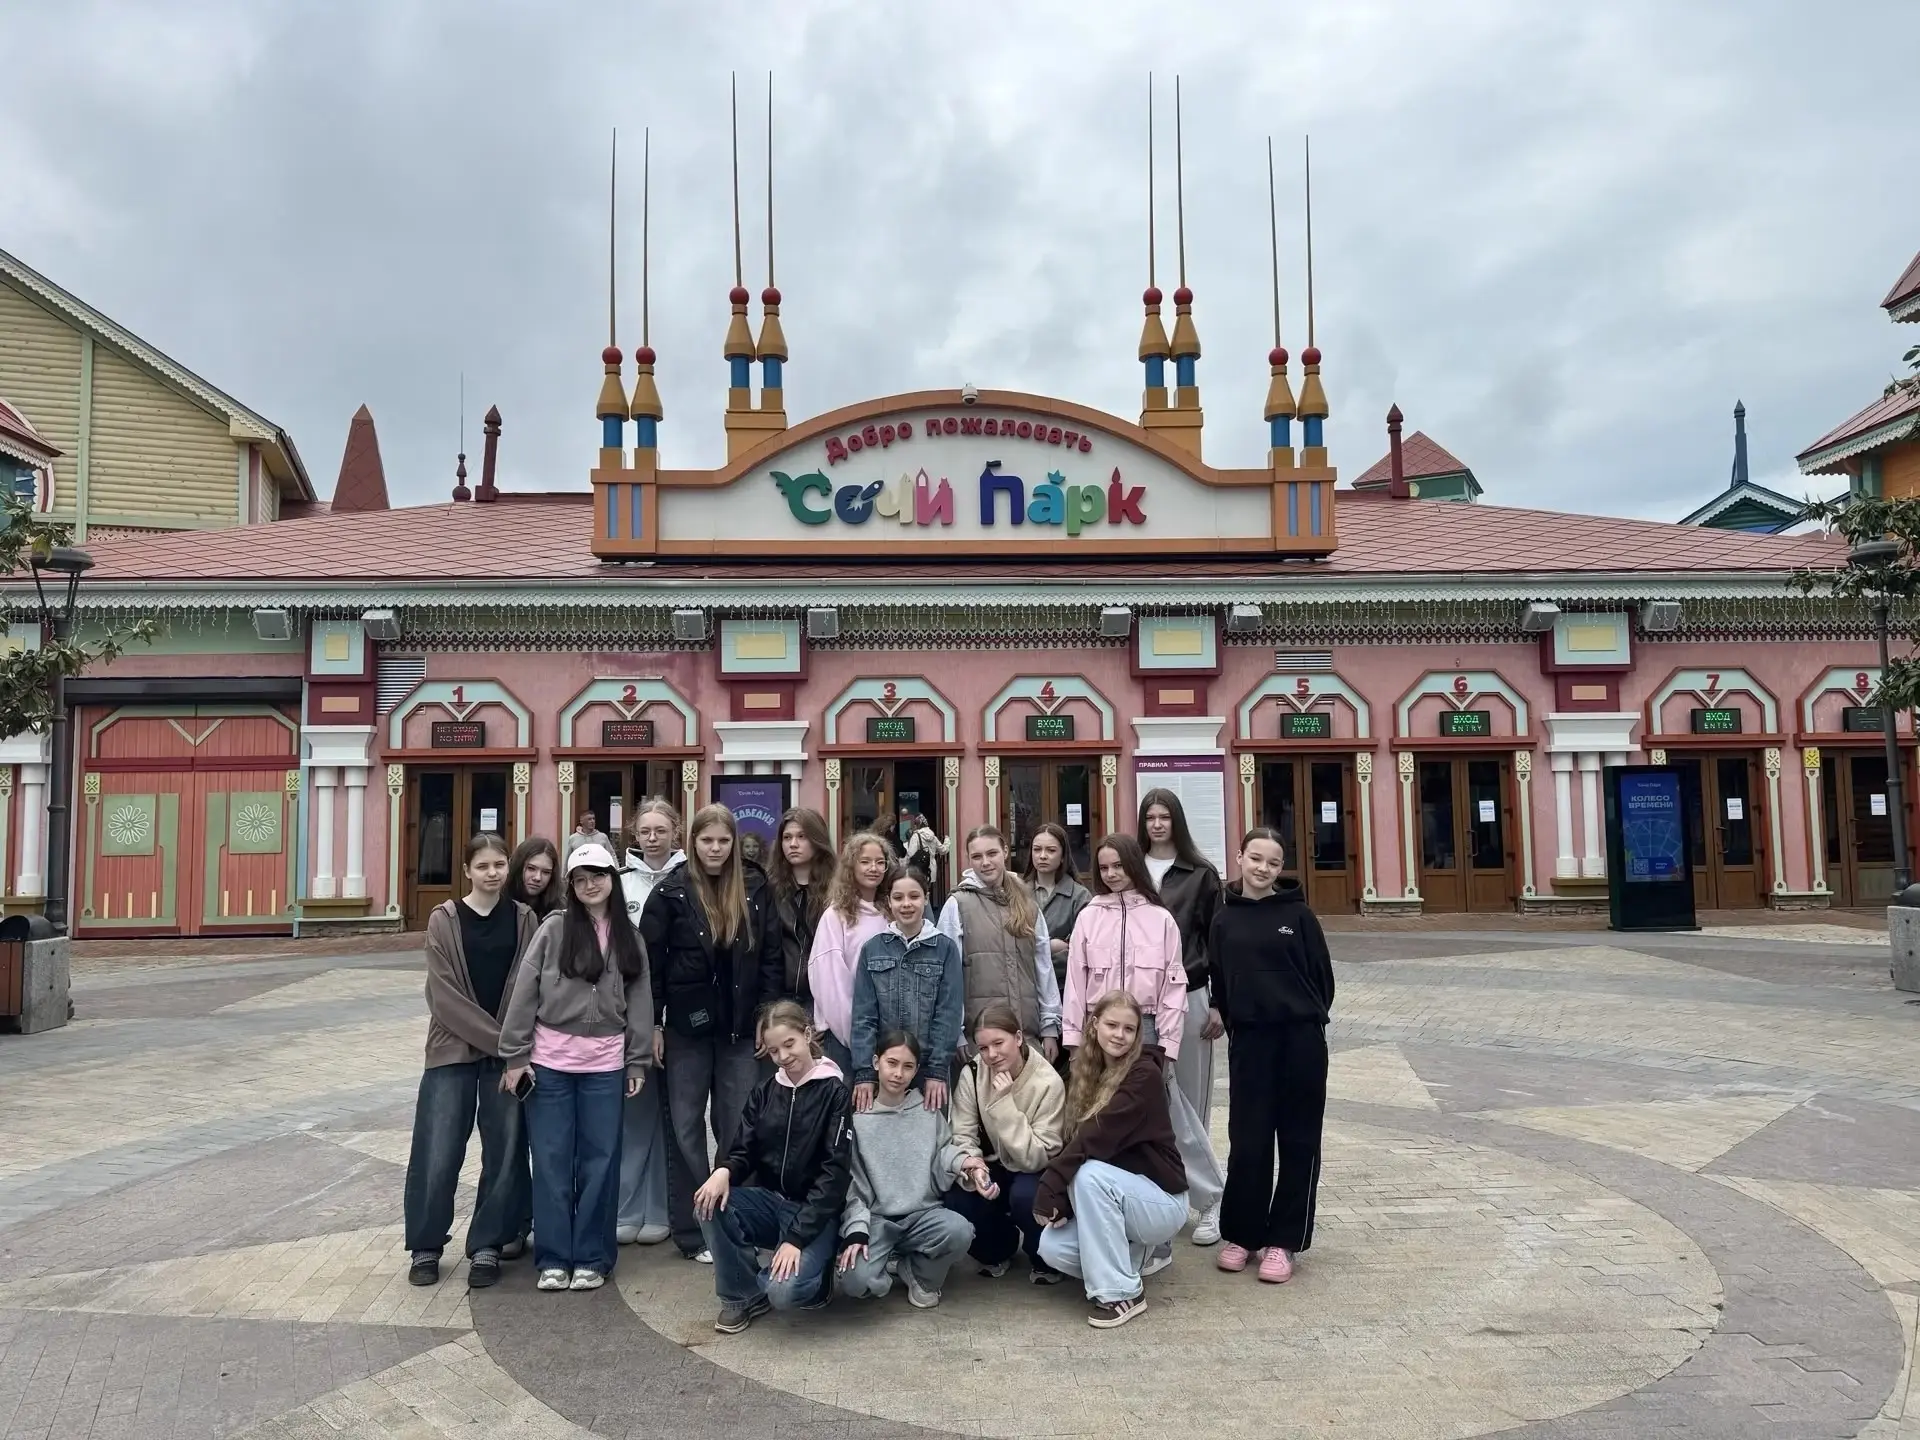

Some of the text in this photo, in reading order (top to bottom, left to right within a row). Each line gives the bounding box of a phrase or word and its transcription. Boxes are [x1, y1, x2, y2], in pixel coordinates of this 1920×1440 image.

[824, 416, 1093, 466] Добро пожаловать
[769, 467, 955, 526] Сочи
[1040, 680, 1055, 698] 4
[1296, 678, 1310, 697] 5
[1453, 676, 1468, 696] 6
[1706, 674, 1720, 693] 7
[1855, 673, 1869, 691] 8
[452, 685, 464, 705] 1
[622, 684, 637, 704] 2
[883, 682, 897, 701] 3
[1036, 719, 1064, 728] ВХОД
[1293, 717, 1320, 726] ВХОД
[1453, 715, 1480, 724] ВХОД
[1705, 712, 1731, 721] ВХОД
[878, 722, 905, 731] ВХОД
[1036, 729, 1066, 737] ENTRY
[1628, 801, 1673, 809] ВРЕМЕНИ
[733, 808, 775, 826] ЕДВЕДИЯ
